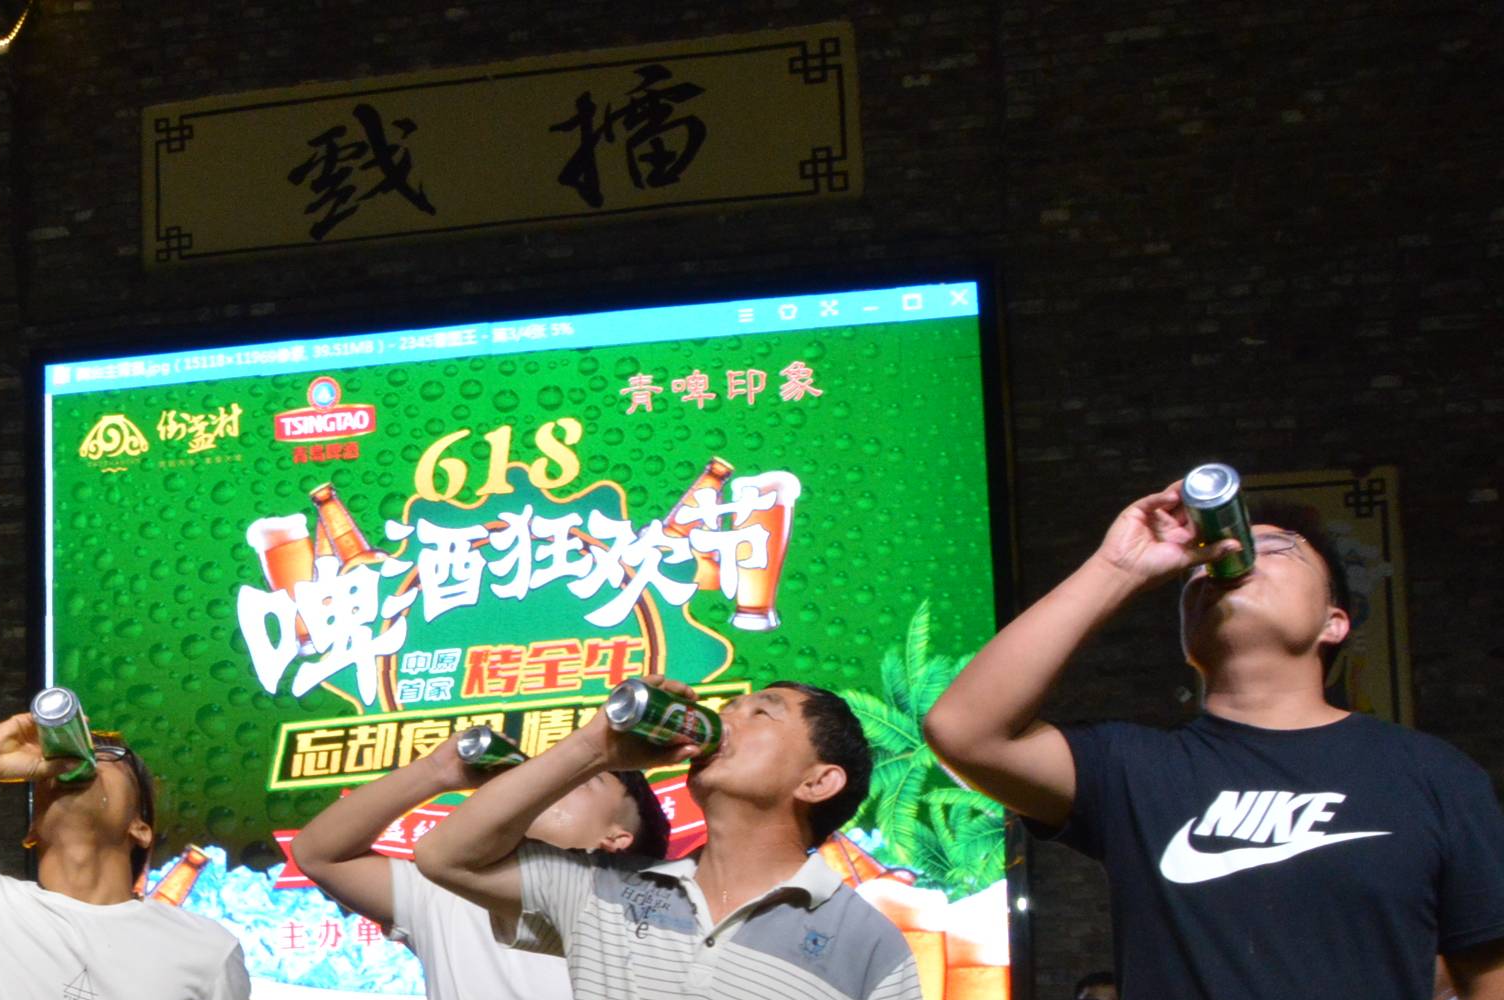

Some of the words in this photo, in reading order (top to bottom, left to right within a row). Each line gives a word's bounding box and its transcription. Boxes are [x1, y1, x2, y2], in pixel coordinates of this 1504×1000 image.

[620, 361, 824, 415] 青啤印象
[280, 410, 369, 437] TSINGTAO
[415, 418, 583, 501] 618
[237, 487, 777, 706] 啤酒狂欢节
[401, 647, 462, 675] 中原
[461, 636, 645, 700] 烤全牛
[397, 678, 454, 703] 首家
[1194, 790, 1346, 843] NIKE
